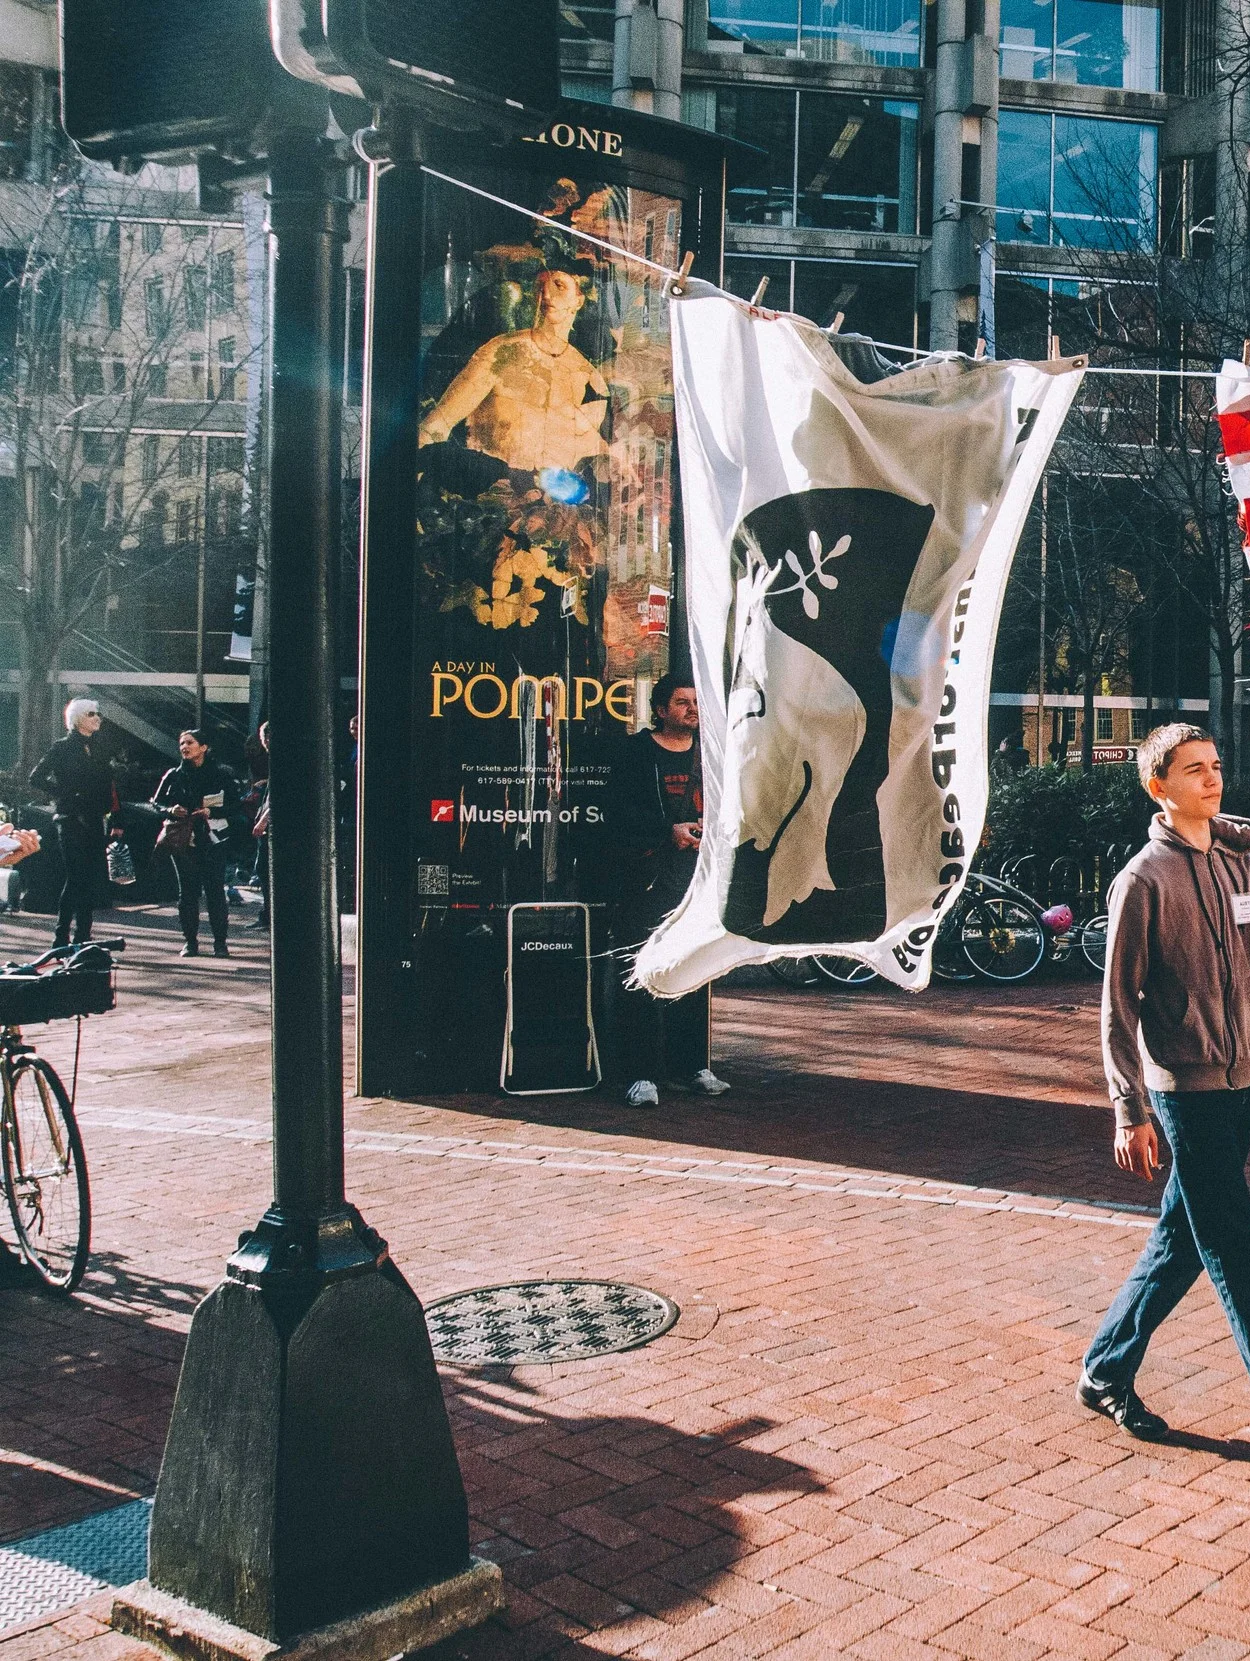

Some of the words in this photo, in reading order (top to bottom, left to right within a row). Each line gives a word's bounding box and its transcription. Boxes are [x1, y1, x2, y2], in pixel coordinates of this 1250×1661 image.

[522, 123, 623, 157] ONE
[431, 661, 442, 672] A
[447, 661, 475, 674] DAY
[480, 662, 495, 673] IN
[430, 672, 636, 724] POMPE
[461, 763, 474, 772] For
[476, 764, 501, 772] tickets
[459, 805, 551, 823] Museum
[559, 806, 580, 823] of
[520, 941, 573, 951] JCDecaux
